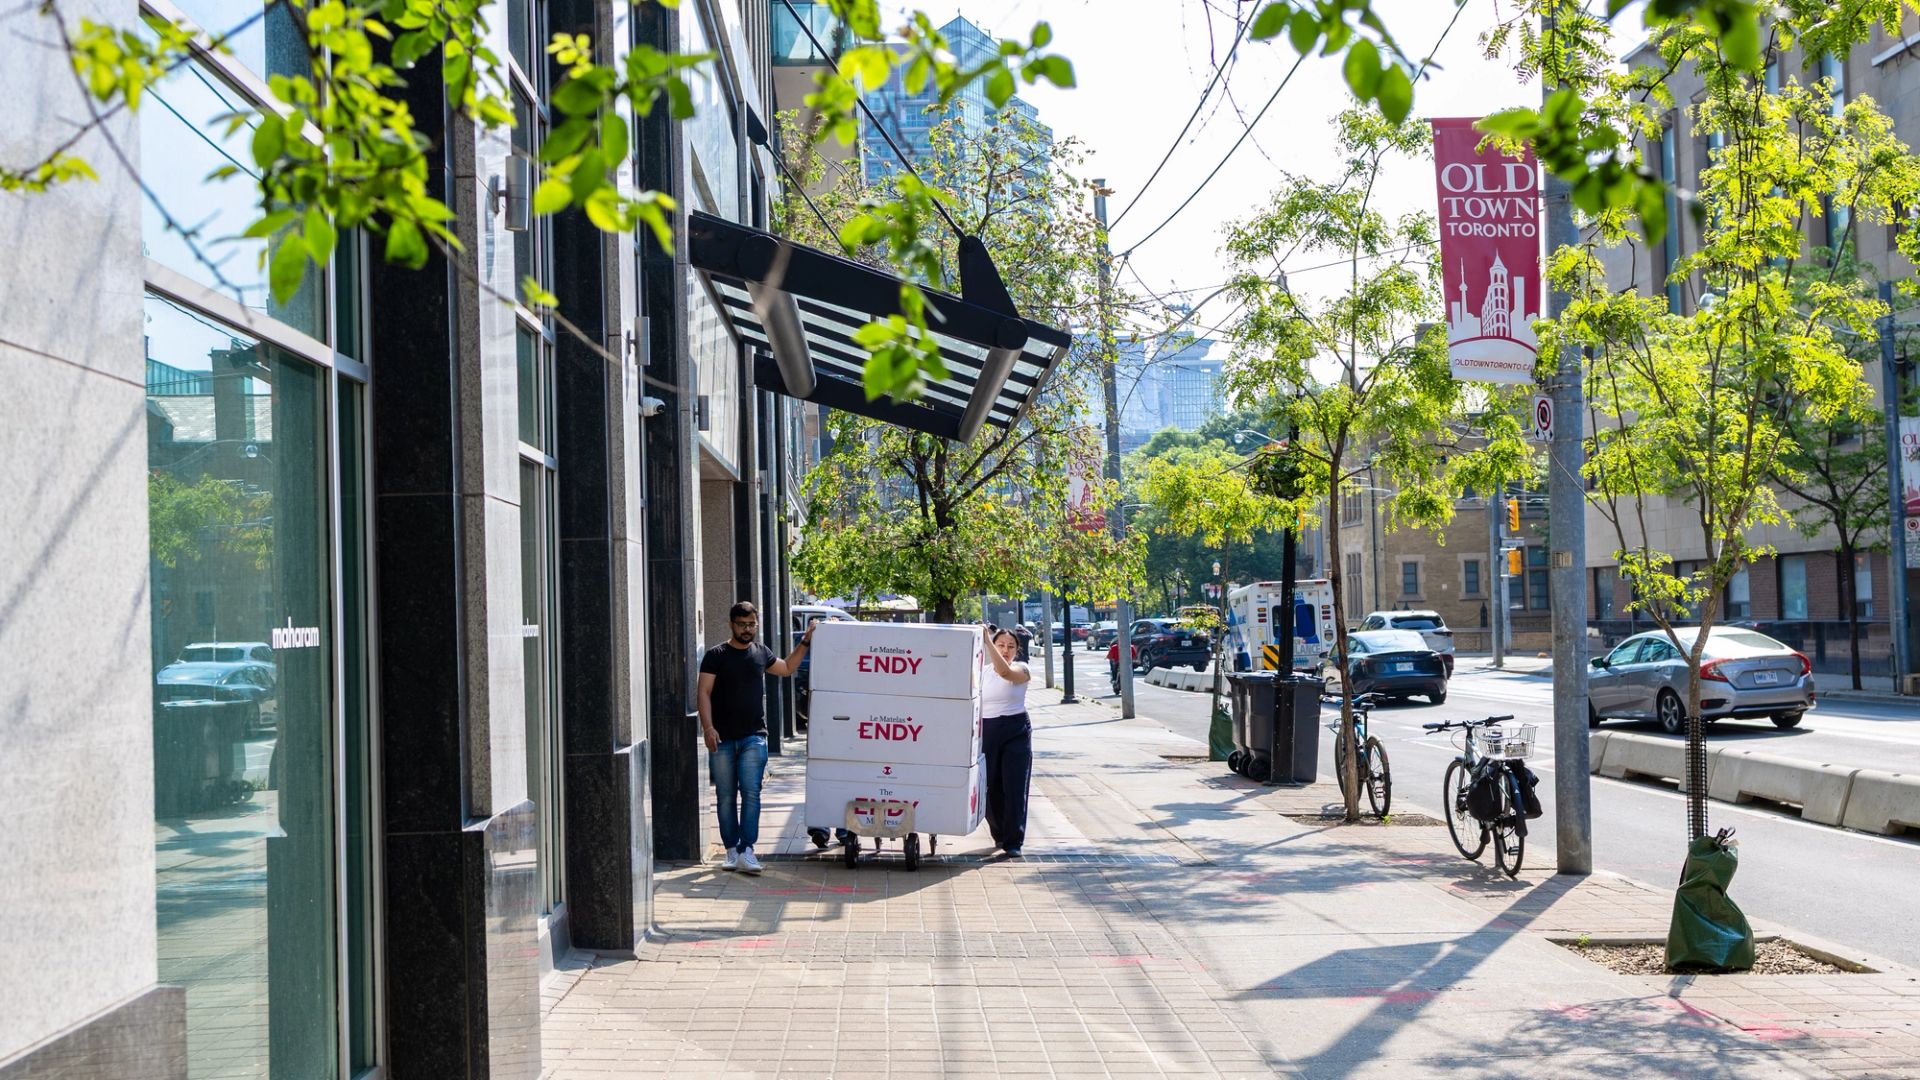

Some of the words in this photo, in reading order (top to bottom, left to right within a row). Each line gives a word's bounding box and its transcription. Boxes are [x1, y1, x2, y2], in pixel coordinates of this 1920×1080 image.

[1441, 163, 1535, 193] OLD
[1443, 197, 1536, 219] TOWN
[1446, 222, 1536, 237] TORONTO
[1455, 358, 1533, 371] OLDTOWNTORONTOCA
[1902, 433, 1920, 446] OL
[272, 616, 320, 649] maharam
[879, 646, 906, 654] Matelas
[857, 655, 922, 675] ENDY
[879, 715, 906, 723] Matelas
[857, 722, 924, 742] ENDY
[879, 788, 893, 796] The
